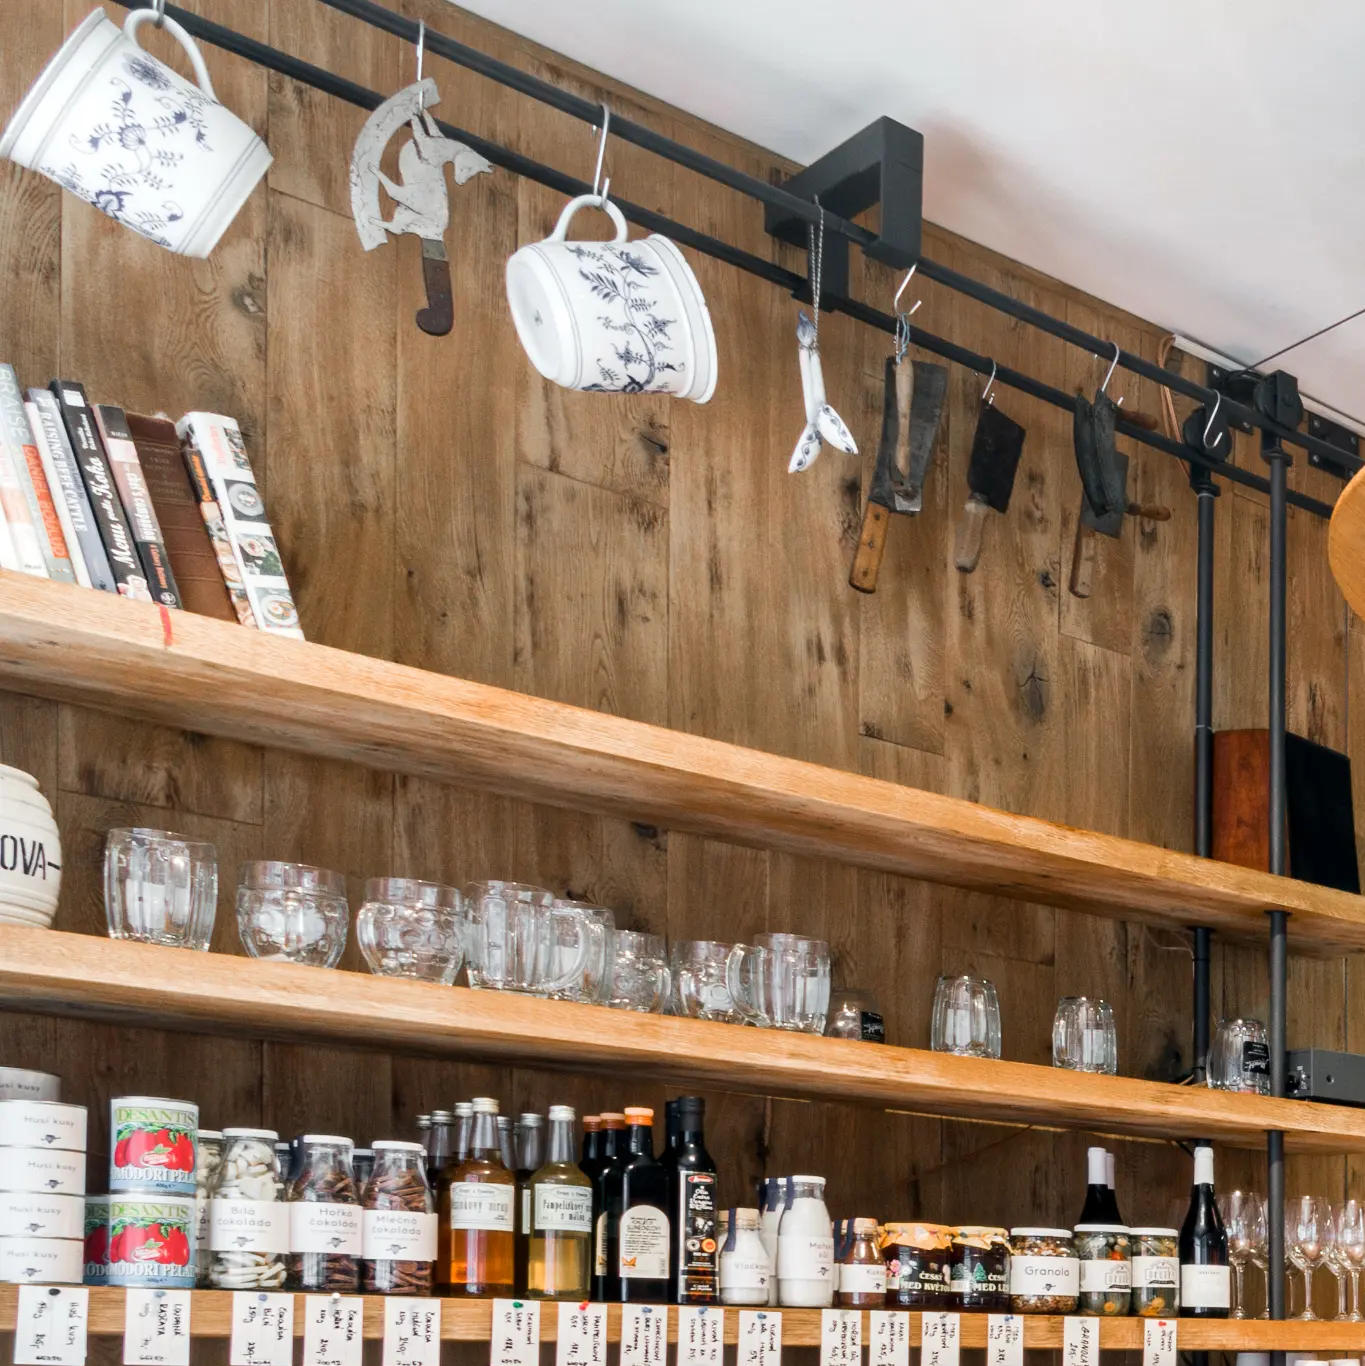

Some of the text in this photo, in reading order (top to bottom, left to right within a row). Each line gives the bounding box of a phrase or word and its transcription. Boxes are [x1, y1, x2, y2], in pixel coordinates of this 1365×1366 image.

[39, 412, 88, 532] RAISING CATTLE
[133, 497, 157, 541] companion
[110, 523, 136, 569] Menu
[117, 1108, 196, 1126] DESANTIS
[112, 1201, 190, 1218] DESANTIS
[217, 1218, 272, 1227] čokoláda
[371, 1223, 422, 1235] čokoláda
[1025, 1265, 1070, 1277] Granola
